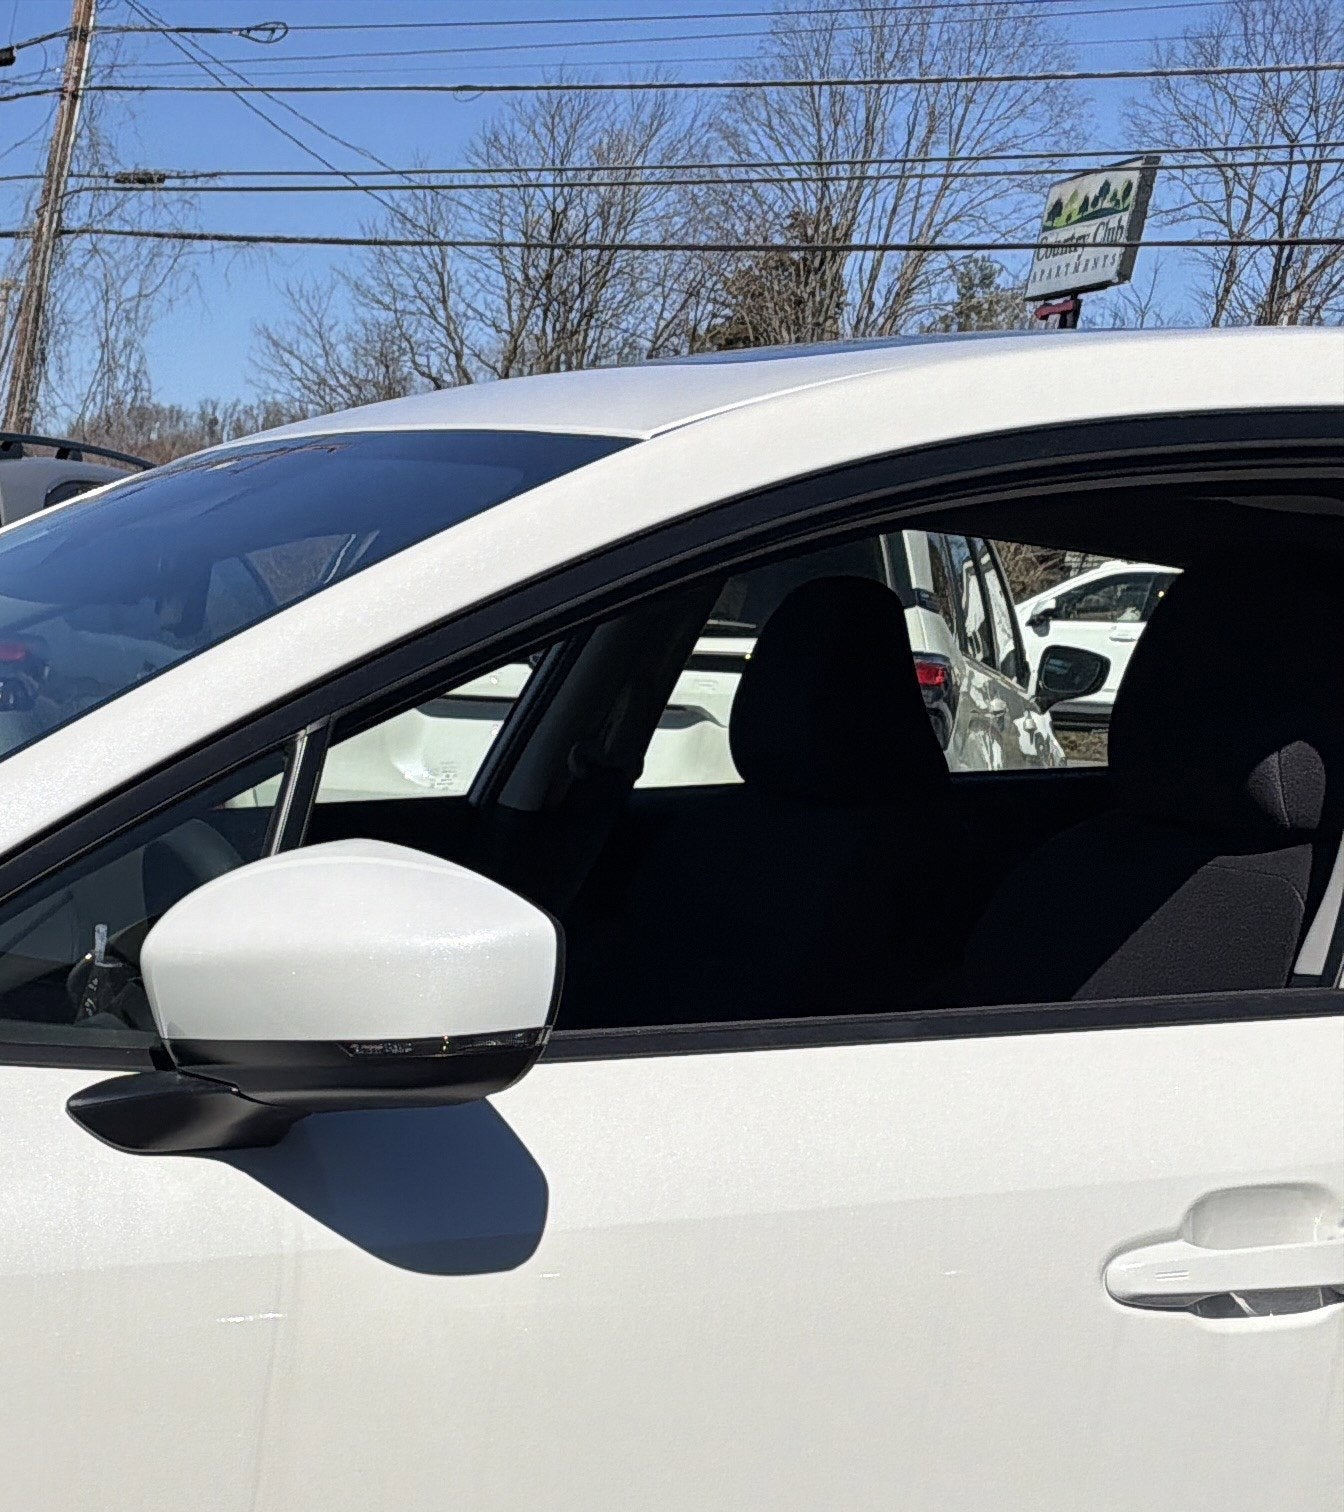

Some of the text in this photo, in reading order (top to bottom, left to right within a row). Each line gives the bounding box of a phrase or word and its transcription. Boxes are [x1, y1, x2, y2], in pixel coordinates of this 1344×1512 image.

[1037, 215, 1125, 261] Country Club
[1032, 253, 1117, 282] APARTMENTS
